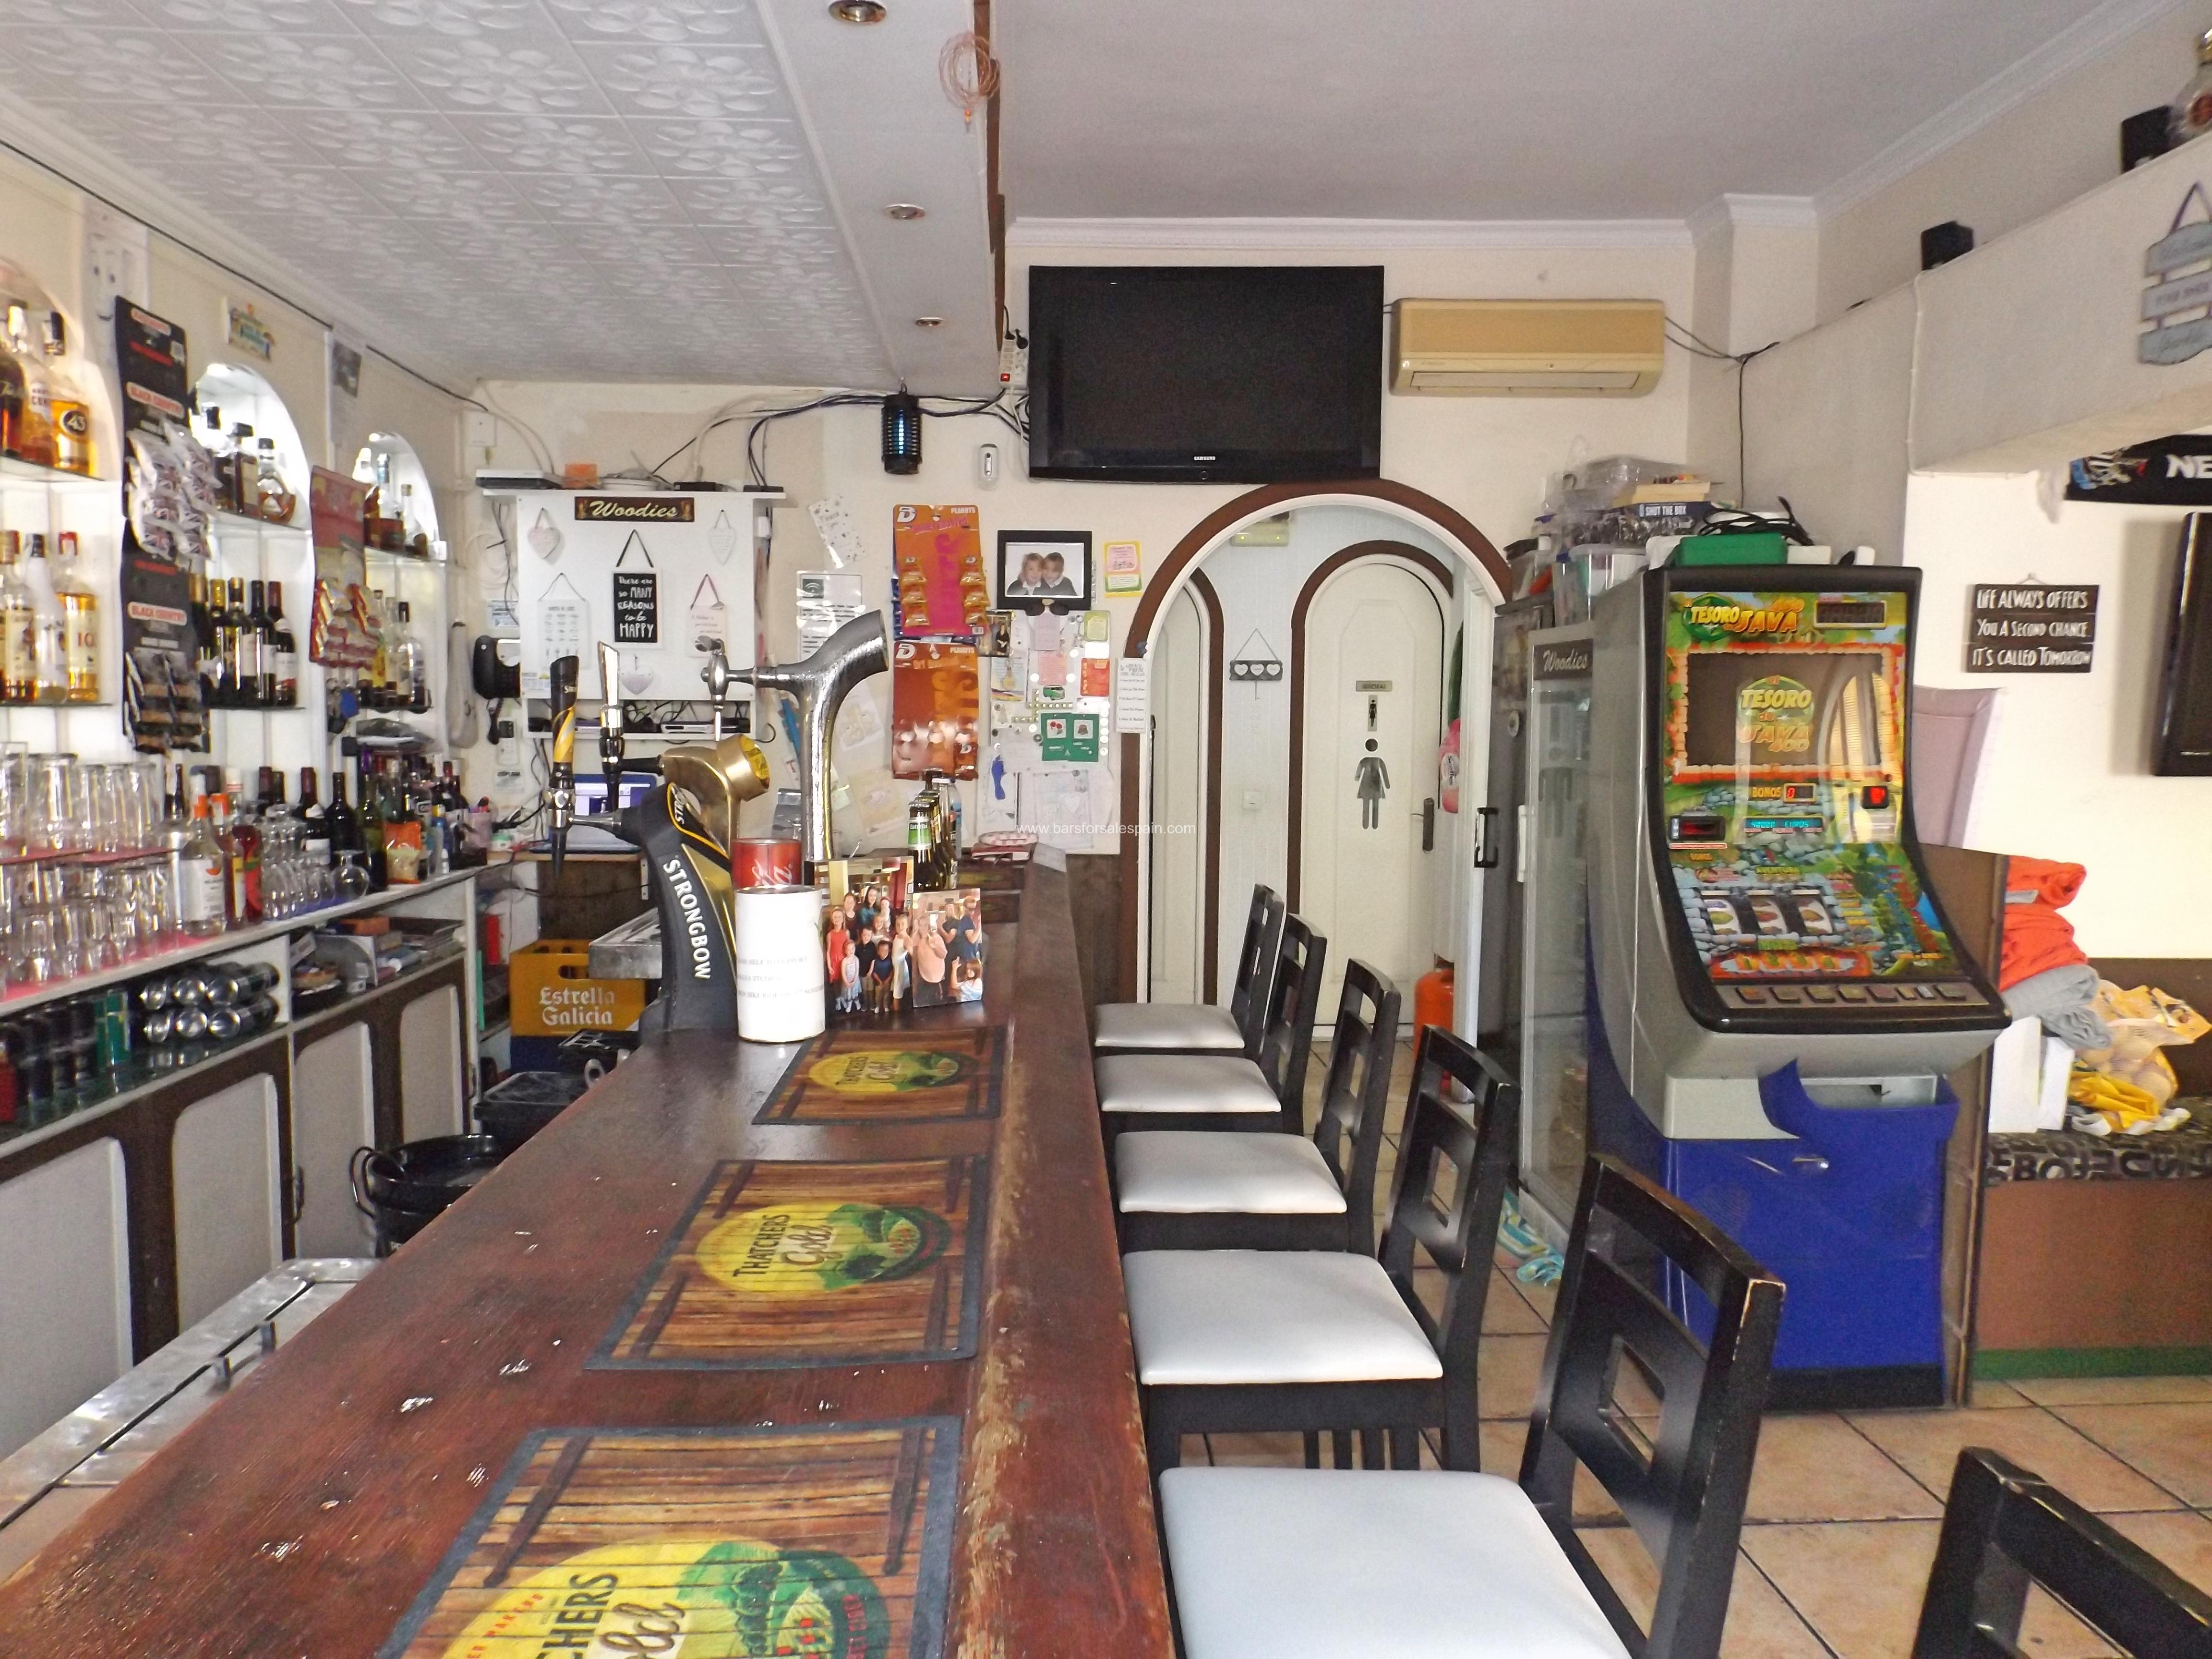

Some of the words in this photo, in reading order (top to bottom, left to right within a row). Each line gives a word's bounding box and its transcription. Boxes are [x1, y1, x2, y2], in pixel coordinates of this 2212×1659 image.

[589, 501, 678, 518] Woodies
[1646, 506, 1660, 516] SHUT
[1662, 505, 1673, 515] THE
[630, 586, 653, 598] MANY
[1998, 589, 2045, 609] ALWAYS
[2047, 590, 2089, 609] OFFERS
[617, 600, 654, 611] REASONS
[1689, 606, 1740, 624] TESORO
[1732, 609, 1798, 633] JAVA
[619, 622, 654, 638] HAPPY
[1999, 620, 2009, 637] A
[1543, 648, 1587, 672] Woodies
[1997, 649, 2037, 666] CALLED
[1741, 689, 1813, 709] TESORO
[1736, 725, 1810, 744] JAVA
[1767, 738, 1810, 752] 400
[662, 859, 711, 980] STRONGBOW
[539, 986, 614, 1005] Estrella
[542, 1006, 613, 1026] Galicia
[733, 1214, 790, 1277] THATCHERS
